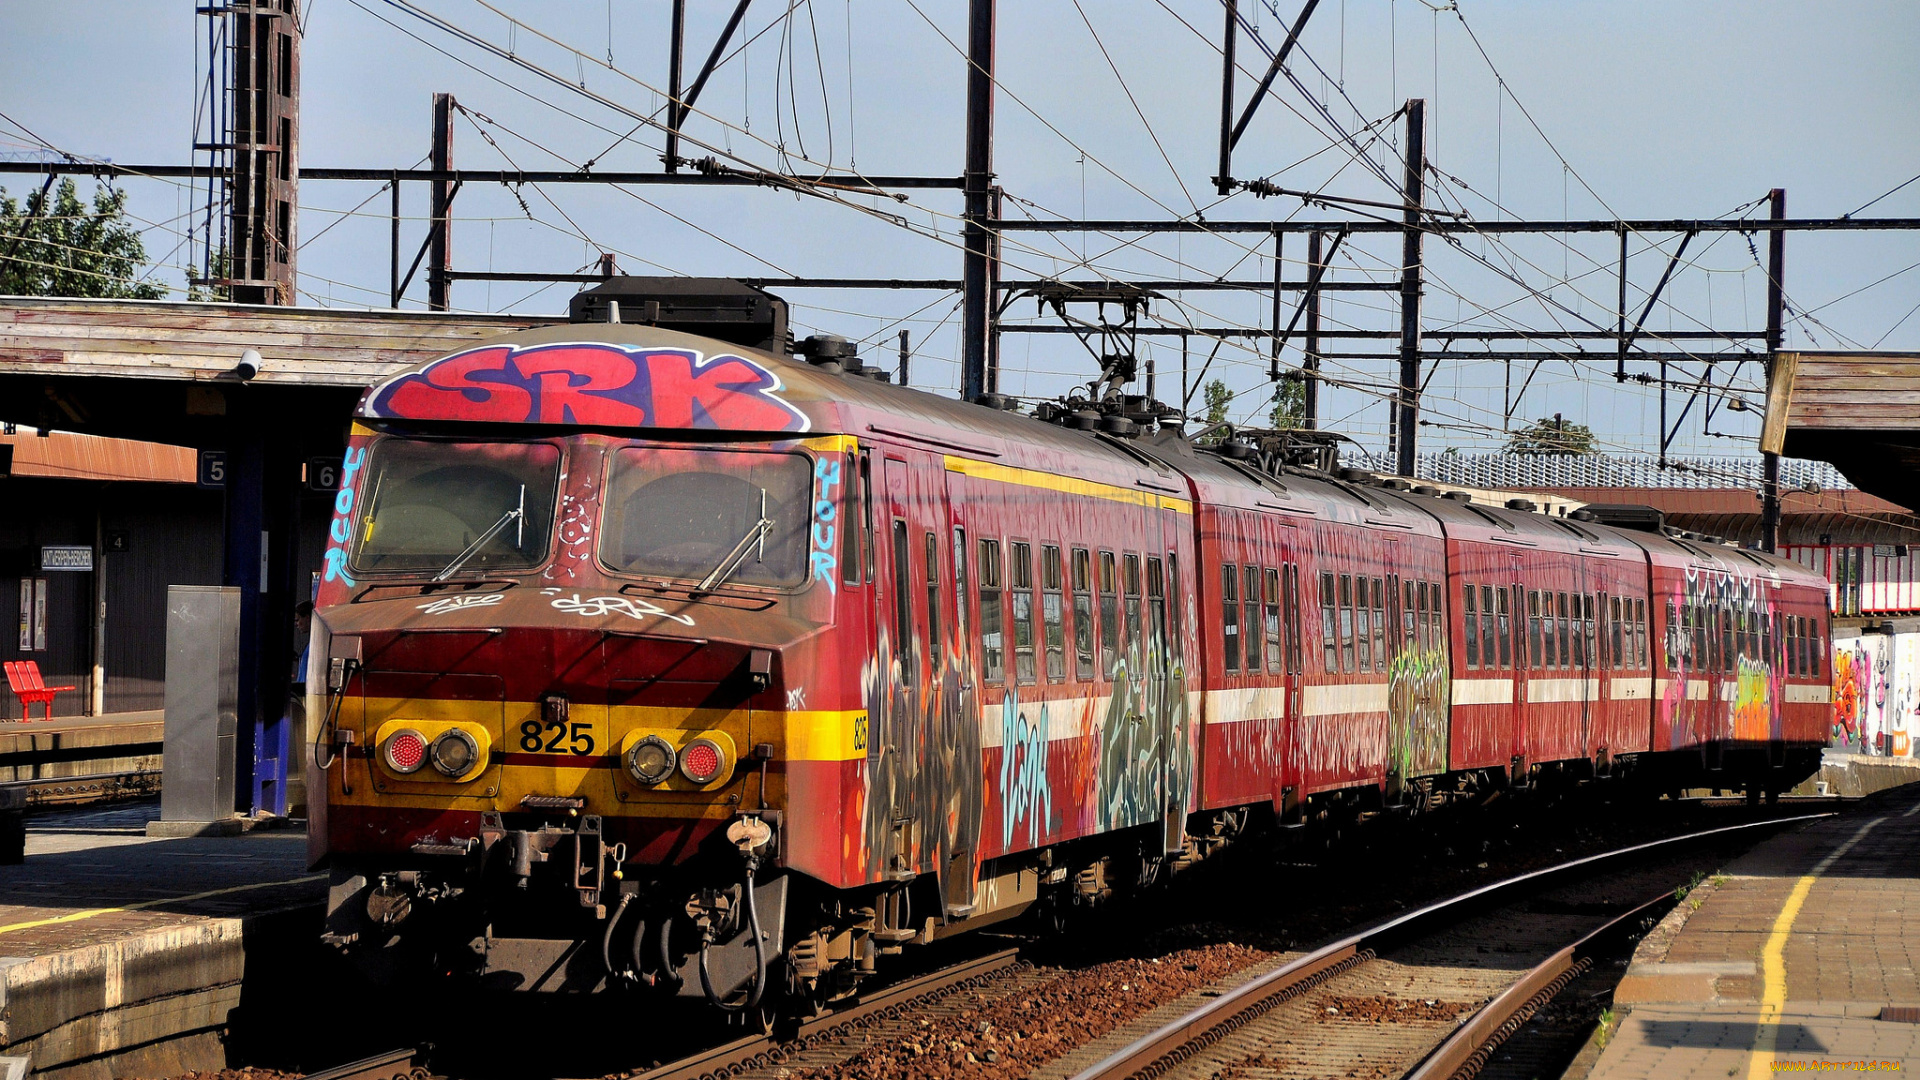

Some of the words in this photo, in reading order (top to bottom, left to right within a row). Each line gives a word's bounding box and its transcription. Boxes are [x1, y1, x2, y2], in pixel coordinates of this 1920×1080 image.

[370, 343, 808, 432] SRK
[210, 460, 225, 481] 5
[319, 466, 335, 487] 6
[324, 445, 366, 588] YOUR
[114, 537, 122, 548] 4
[520, 720, 595, 756] 825
[854, 715, 867, 751] 825
